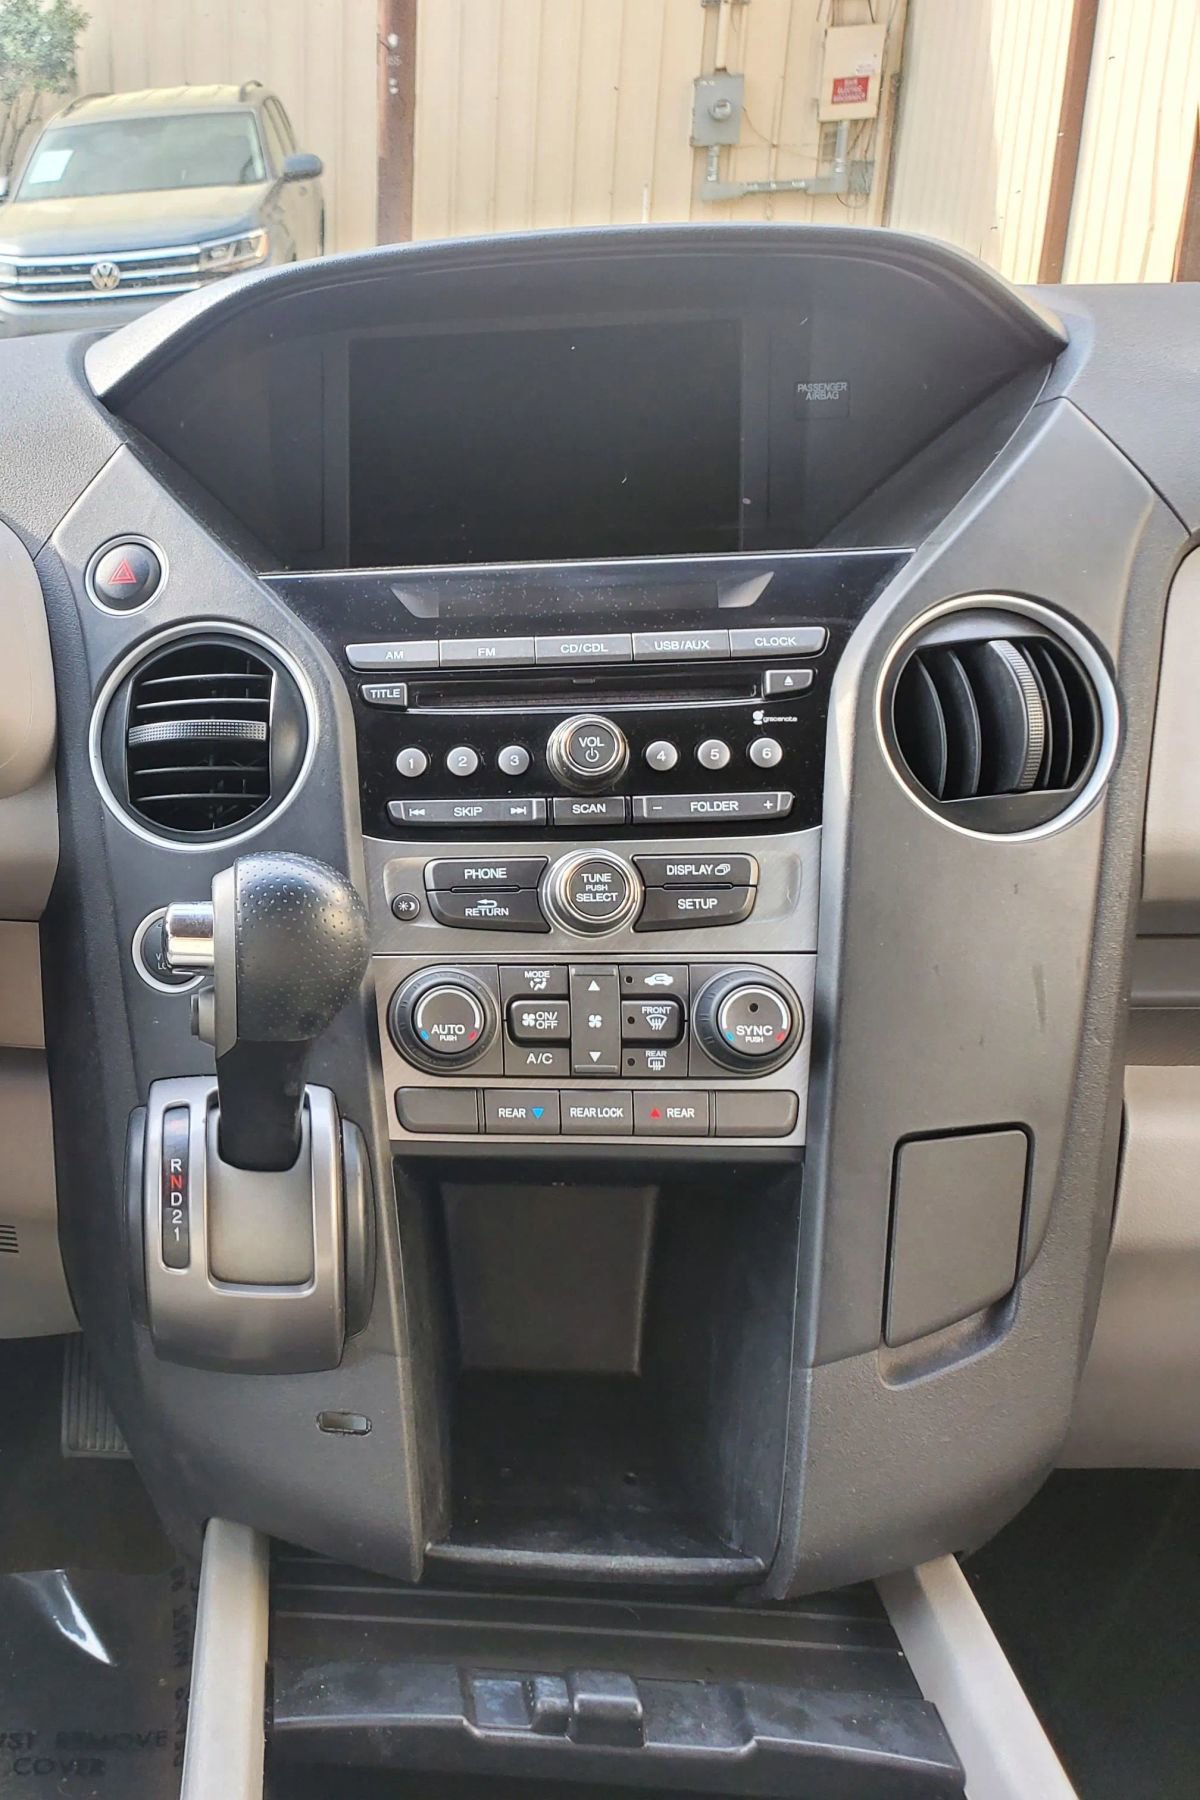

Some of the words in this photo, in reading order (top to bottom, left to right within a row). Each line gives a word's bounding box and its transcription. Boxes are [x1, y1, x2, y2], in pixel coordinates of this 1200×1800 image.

[797, 382, 848, 392] PASSENGER
[805, 391, 839, 400] AIRBAG
[654, 638, 711, 652] USB/AUX
[754, 635, 797, 648] CLOCK
[477, 647, 496, 658] FM
[560, 641, 608, 655] CD/CDL
[385, 648, 404, 661] AM
[370, 687, 401, 700] TITLE
[578, 736, 605, 748] VOL
[656, 750, 667, 763] 4
[710, 748, 720, 761] 5
[762, 747, 772, 759] 6
[407, 757, 415, 770] 1
[458, 755, 468, 768] 2
[510, 755, 520, 767] 3
[453, 805, 483, 818] SKIP
[571, 803, 607, 815] SCAN
[690, 799, 739, 813] FOLDER
[464, 868, 507, 880] PHONE
[666, 863, 713, 876] DISPLAY
[581, 872, 612, 884] TUNE
[575, 892, 618, 903] SELECT
[677, 897, 718, 910] SETUP
[465, 906, 509, 918] RETURN
[524, 970, 550, 979] MODE
[536, 1010, 558, 1021] ON/
[642, 1006, 671, 1015] FRONT
[431, 1023, 465, 1035] AUTO
[536, 1019, 558, 1030] OFF
[736, 1024, 773, 1036] SYNC
[526, 1052, 553, 1065] A/C
[645, 1050, 667, 1058] REAR
[498, 1107, 526, 1119] REAR
[570, 1107, 596, 1118] REAR
[597, 1107, 624, 1118] LOCK
[667, 1107, 695, 1118] REAR
[170, 1158, 182, 1172] R
[170, 1175, 182, 1188] N
[171, 1192, 182, 1206] D
[172, 1210, 182, 1224] 2
[174, 1227, 180, 1241] 1
